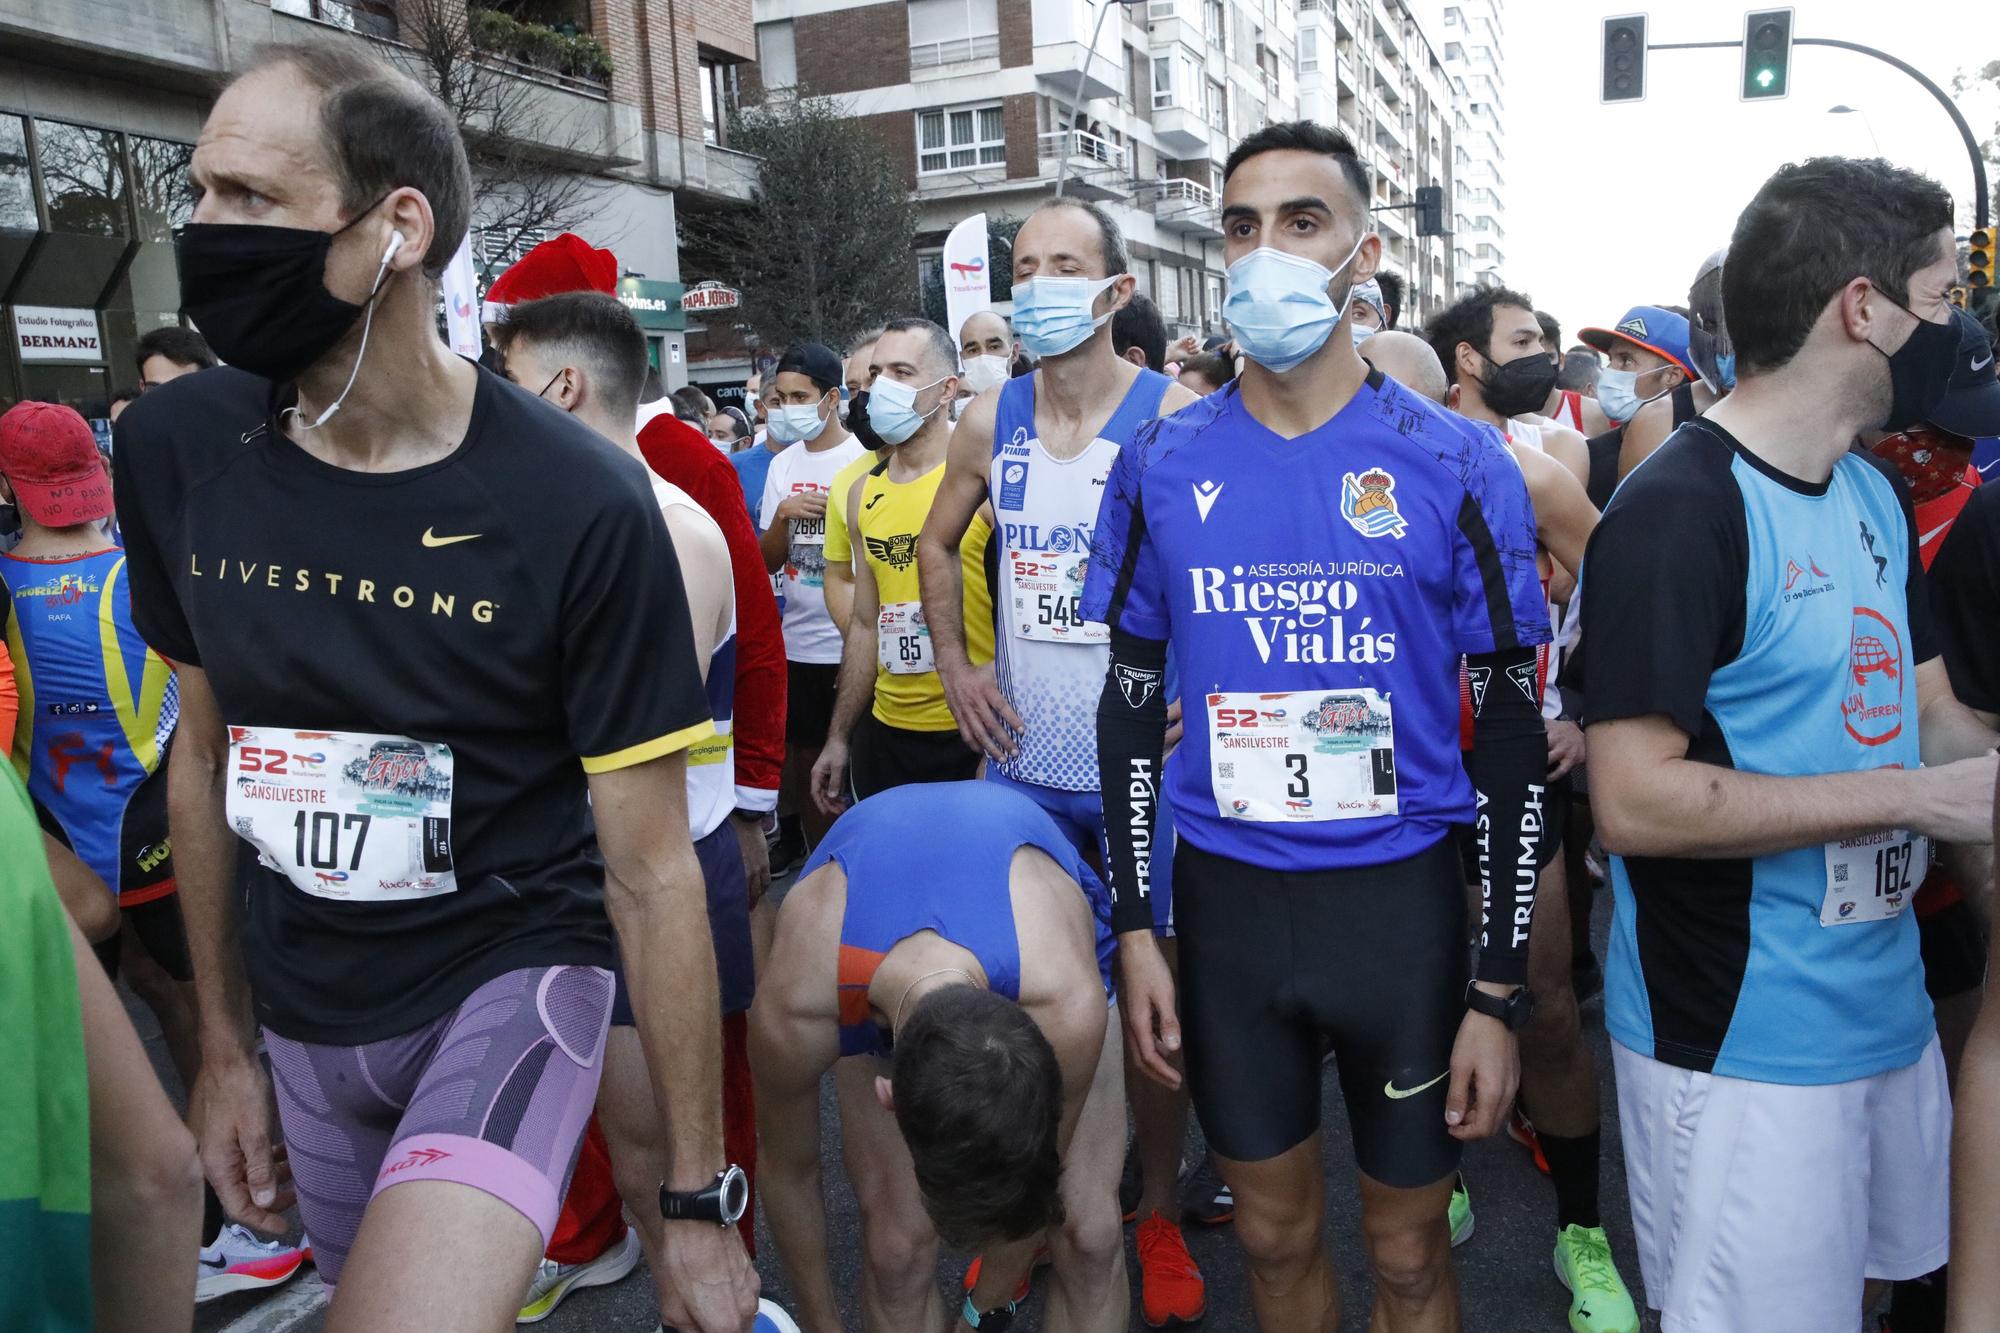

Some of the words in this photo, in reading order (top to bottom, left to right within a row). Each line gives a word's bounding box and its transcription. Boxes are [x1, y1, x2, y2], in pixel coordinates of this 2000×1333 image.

[683, 291, 705, 308] PAPA
[707, 289, 736, 306] JOHNS
[18, 315, 48, 327] Estudio
[50, 317, 94, 329] Fotografico
[21, 335, 97, 349] BERMANZ
[1004, 445, 1031, 457] VIATOR
[50, 486, 74, 499] NO
[81, 485, 106, 499] PAIN
[42, 503, 63, 516] NO
[72, 502, 105, 519] GAIN
[794, 517, 825, 535] 2680
[889, 535, 911, 547] BORN
[890, 551, 911, 564] RUN
[1014, 561, 1040, 577] 52
[1248, 559, 1324, 577] ASESORÍA
[1327, 559, 1404, 577] JURÍDICA
[191, 553, 495, 623] LIVESTRONG
[1018, 581, 1058, 592] SANSILVESTRE
[1188, 564, 1358, 628] Riesgo
[48, 613, 72, 622] RAFA
[880, 612, 894, 623] 52
[899, 635, 922, 661] 85
[1244, 616, 1397, 664] Vialás
[1123, 668, 1156, 681] TRIUMPH
[1217, 708, 1259, 728] 52
[1223, 737, 1290, 749] SANSILVESTRE
[239, 746, 288, 775] 52
[1285, 753, 1310, 798] 3
[244, 784, 327, 804] SANSILVESTRE
[1130, 758, 1158, 898] TRIUMPH
[294, 809, 372, 871] 107
[439, 840, 448, 855] 107
[1839, 830, 1894, 849] SANSILVESTRE
[1512, 783, 1545, 949] TRIUMPH
[1875, 841, 1912, 897] 162
